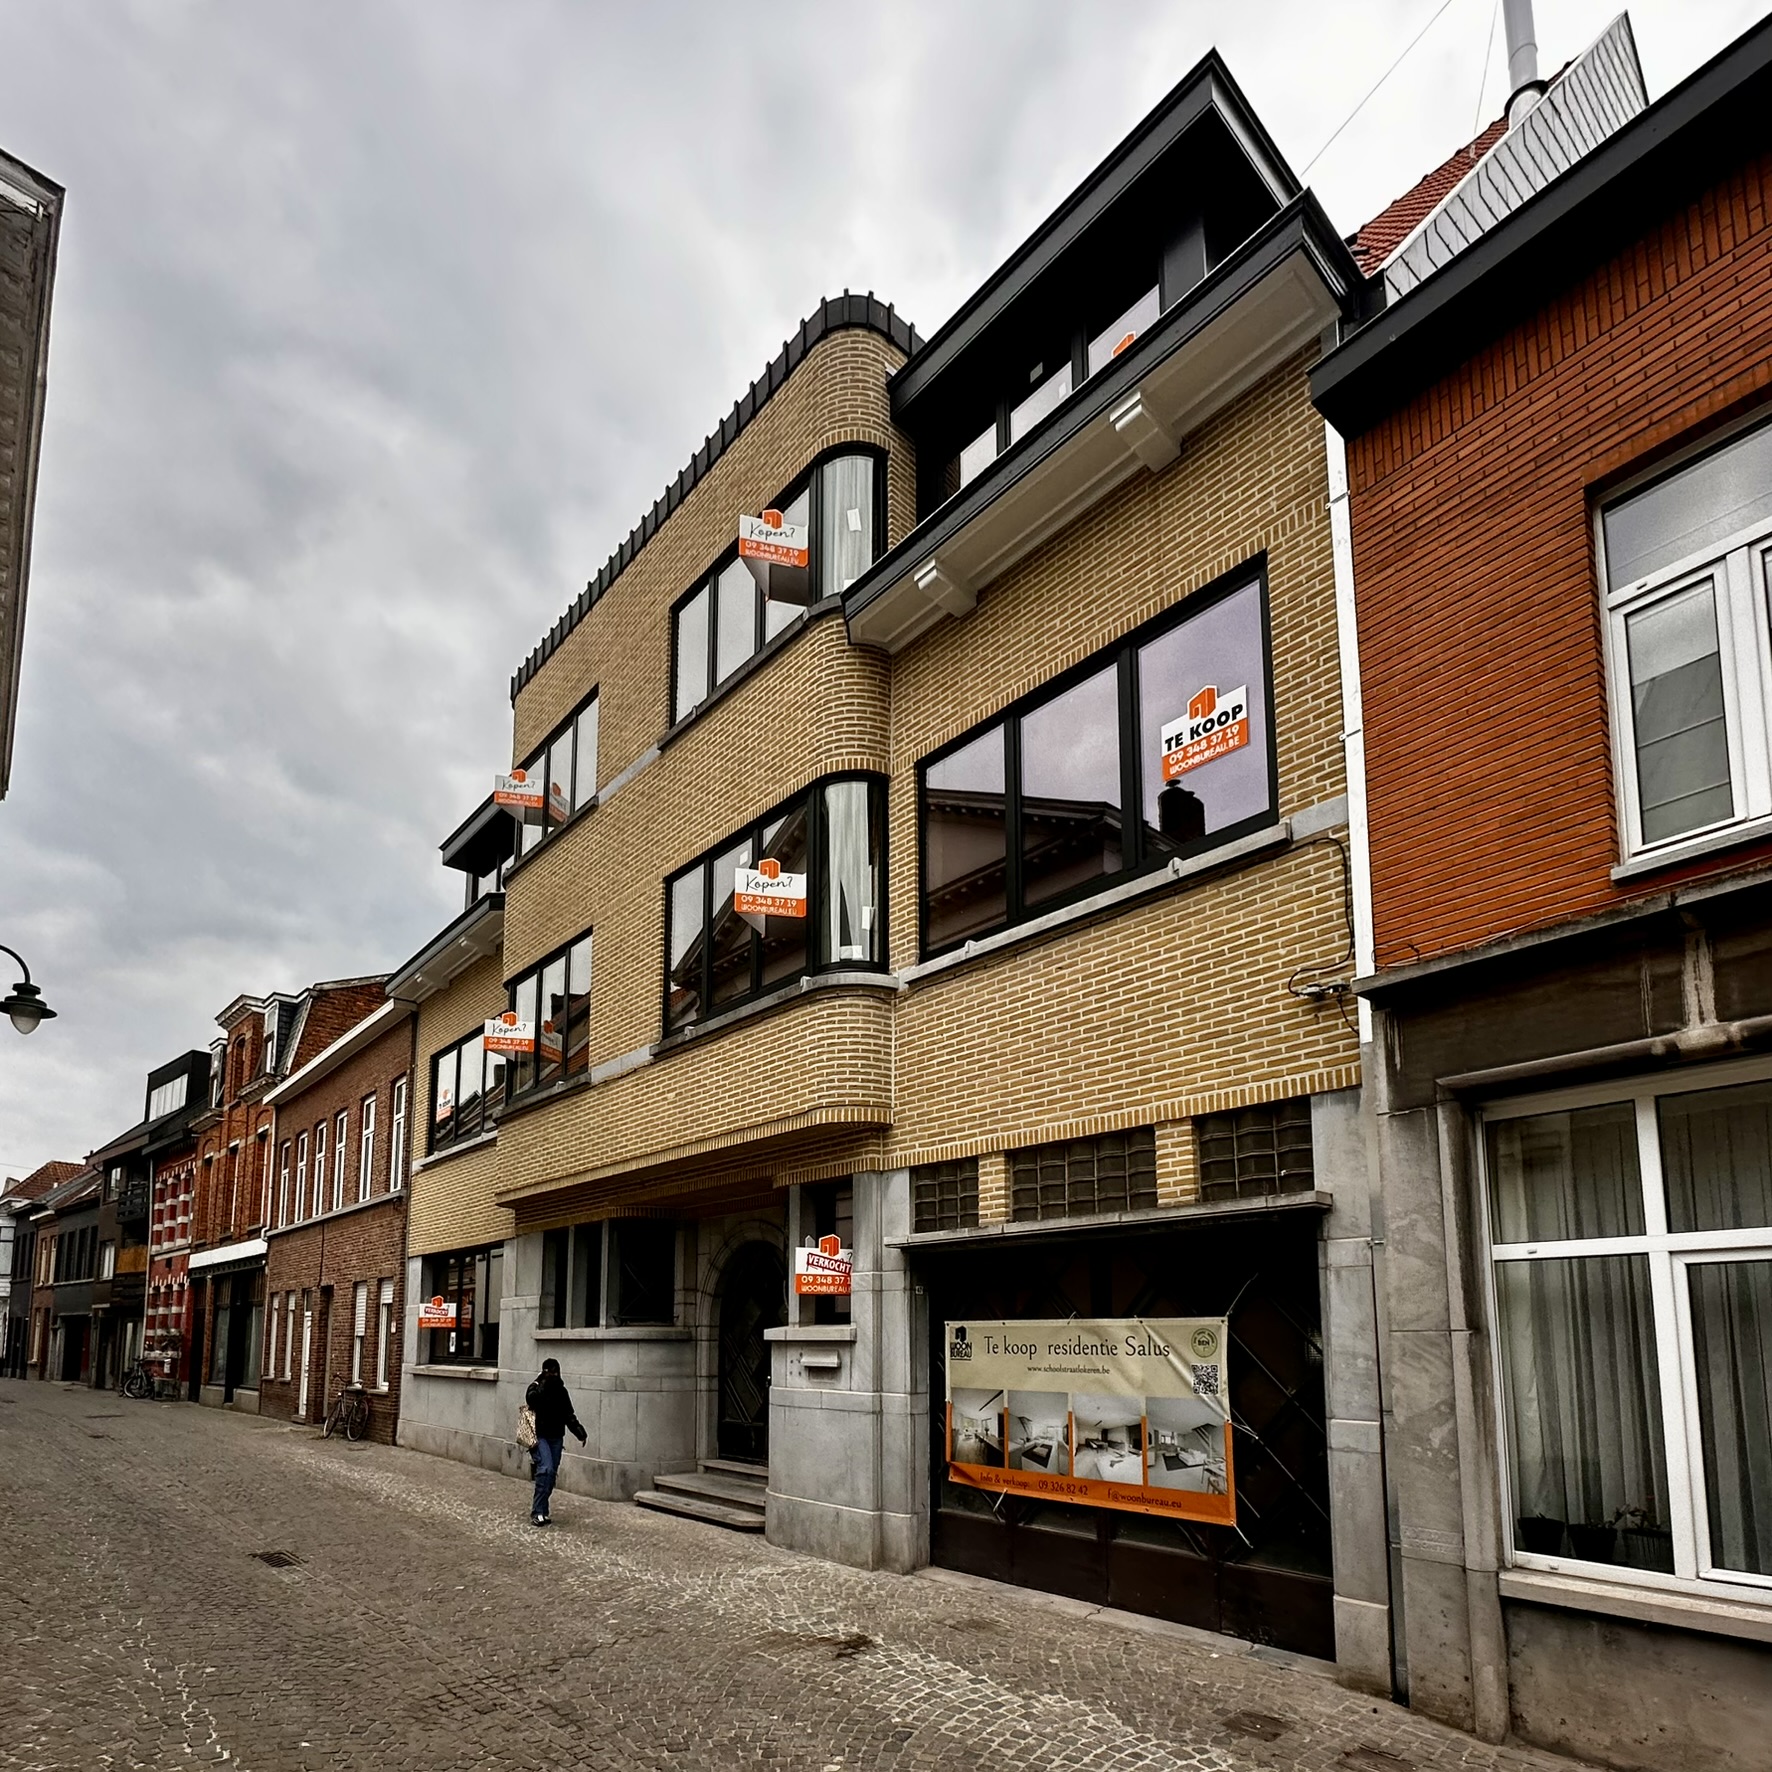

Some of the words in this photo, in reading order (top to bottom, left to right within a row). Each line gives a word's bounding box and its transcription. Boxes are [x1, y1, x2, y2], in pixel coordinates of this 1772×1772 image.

[750, 522, 795, 541] Kopen?
[759, 544, 775, 553] 348
[1165, 731, 1183, 752] TE
[1189, 704, 1243, 741] KOOP
[1169, 751, 1184, 764] 09
[1186, 739, 1207, 756] 348
[1210, 731, 1223, 746] 37
[1225, 725, 1239, 738] 19
[1169, 736, 1240, 774] WOONBUREAU.BE
[502, 779, 535, 791] Kopen?
[746, 874, 793, 893] Kopen?
[755, 896, 772, 905] 348
[775, 898, 784, 906] 37
[492, 1023, 526, 1036] Kopen?
[808, 1253, 851, 1274] VERKOCHT
[816, 1276, 832, 1284] 348
[984, 1336, 999, 1354] Te
[1003, 1335, 1037, 1360] koop
[1048, 1335, 1118, 1356] residentie
[1125, 1334, 1170, 1357] Salus
[980, 1472, 992, 1482] Info
[994, 1474, 1000, 1483] &
[1038, 1480, 1048, 1489] 09
[1051, 1481, 1064, 1492] 326
[1066, 1483, 1076, 1494] 82
[1078, 1485, 1088, 1495] 42
